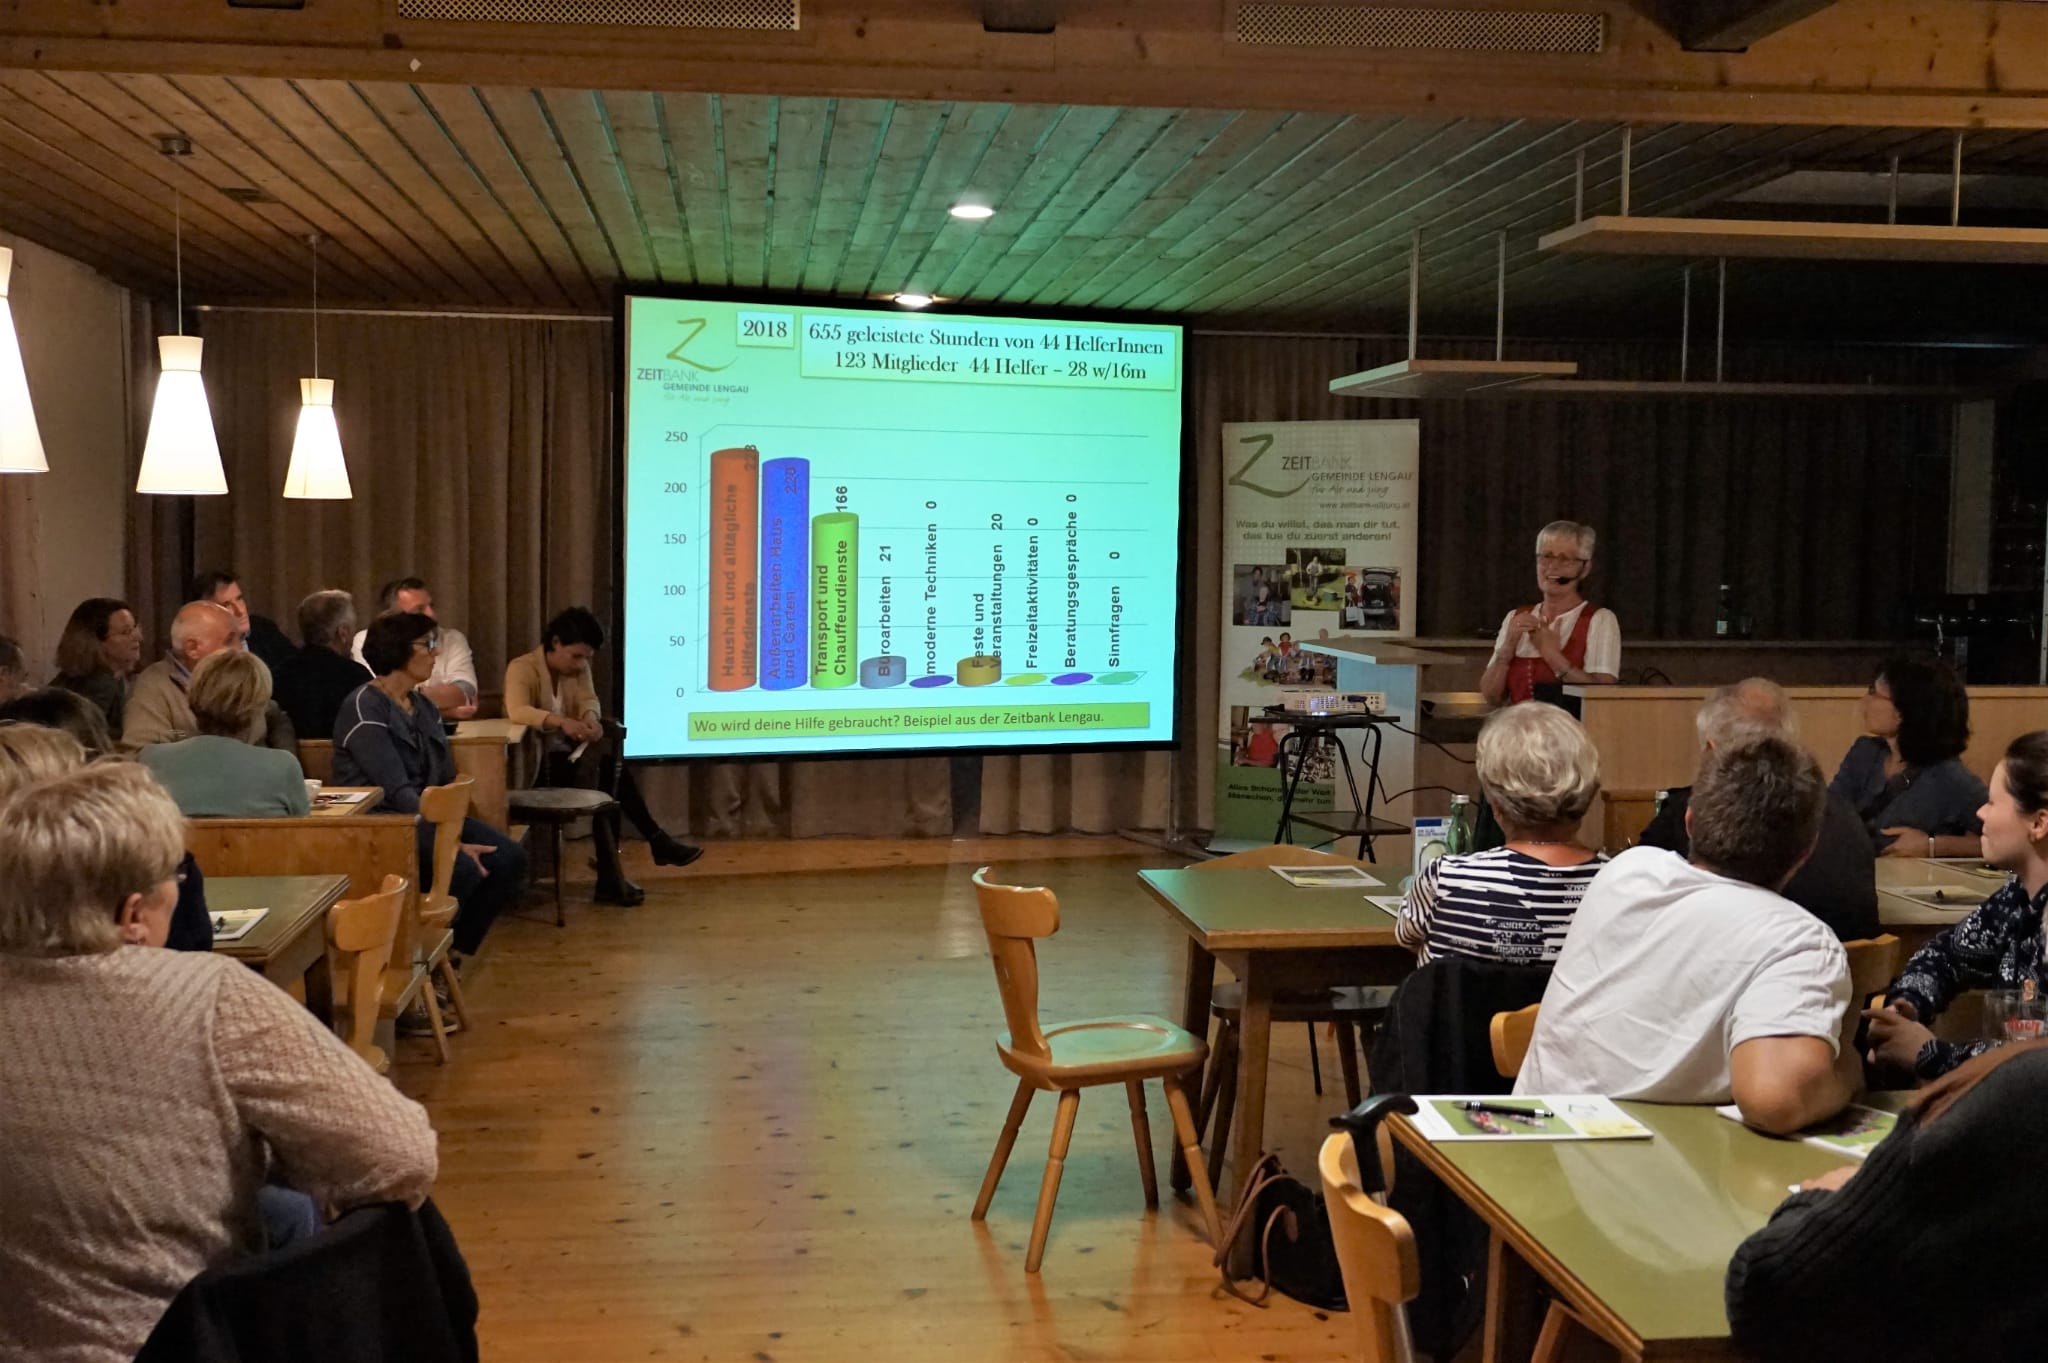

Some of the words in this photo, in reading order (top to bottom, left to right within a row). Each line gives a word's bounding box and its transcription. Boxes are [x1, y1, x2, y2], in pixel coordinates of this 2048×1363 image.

[743, 319, 788, 338] 2018
[809, 323, 842, 341] 655
[847, 325, 925, 345] geleistete
[929, 328, 999, 348] Stunden
[1005, 336, 1034, 350] von
[1040, 333, 1060, 350] 44
[1065, 334, 1164, 355] HelferInnen
[637, 367, 699, 382] ZEITBANK
[836, 351, 866, 369] 123
[872, 352, 960, 375] Mitglieder
[969, 357, 990, 374] 44
[996, 357, 1048, 377] Helfer
[1067, 360, 1088, 378] 28
[1093, 362, 1147, 381] w/16m
[663, 382, 711, 393] GEMEINDE
[713, 383, 749, 393] LENGAU
[664, 431, 689, 443] 250
[1281, 455, 1352, 472] ZEITBANK
[1311, 472, 1367, 482] GEMEINDE
[1369, 471, 1413, 482] LENGAU
[663, 481, 687, 494] 200
[784, 466, 798, 495] 220
[835, 485, 849, 513] 166
[769, 517, 783, 558] Haus
[991, 513, 1003, 532] 20
[1236, 519, 1257, 529] Was
[1261, 519, 1275, 529] du
[1336, 520, 1361, 529] man
[1363, 519, 1378, 529] dir
[1242, 531, 1262, 541] das
[1286, 531, 1301, 541] du
[1303, 531, 1339, 541] zuerst
[664, 533, 687, 546] 150
[879, 544, 892, 563] 21
[924, 522, 938, 602] Techniken
[663, 584, 687, 597] 100
[723, 570, 736, 602] und
[816, 564, 829, 595] und
[1065, 510, 1080, 669] Beratungsgespräche
[783, 590, 797, 643] Garten
[833, 539, 848, 677] Chauffeurdienste
[972, 592, 985, 624] und
[990, 543, 1006, 669] Veranstaltungen
[1026, 534, 1040, 669] Freizeitaktivitäten
[767, 562, 783, 679] Außenarbeiten
[878, 575, 892, 677] Büroarbeiten
[1109, 585, 1124, 669] Sinnfragen
[669, 635, 686, 648] 50
[722, 605, 737, 678] Haushalt
[815, 597, 831, 676] Transport
[925, 606, 937, 675] moderne
[972, 626, 985, 669] Feste
[784, 647, 796, 680] und
[676, 687, 685, 698] 0
[694, 720, 718, 733] Wo
[721, 719, 751, 732] wird
[754, 718, 792, 732] deine
[795, 717, 826, 731] Hilfe
[828, 714, 900, 732] gebraucht?
[904, 713, 952, 729] Beispiel
[955, 715, 976, 727] aus
[979, 713, 1000, 725] der
[1003, 709, 1055, 725] Zeitbank
[1058, 710, 1104, 726] Lengau.
